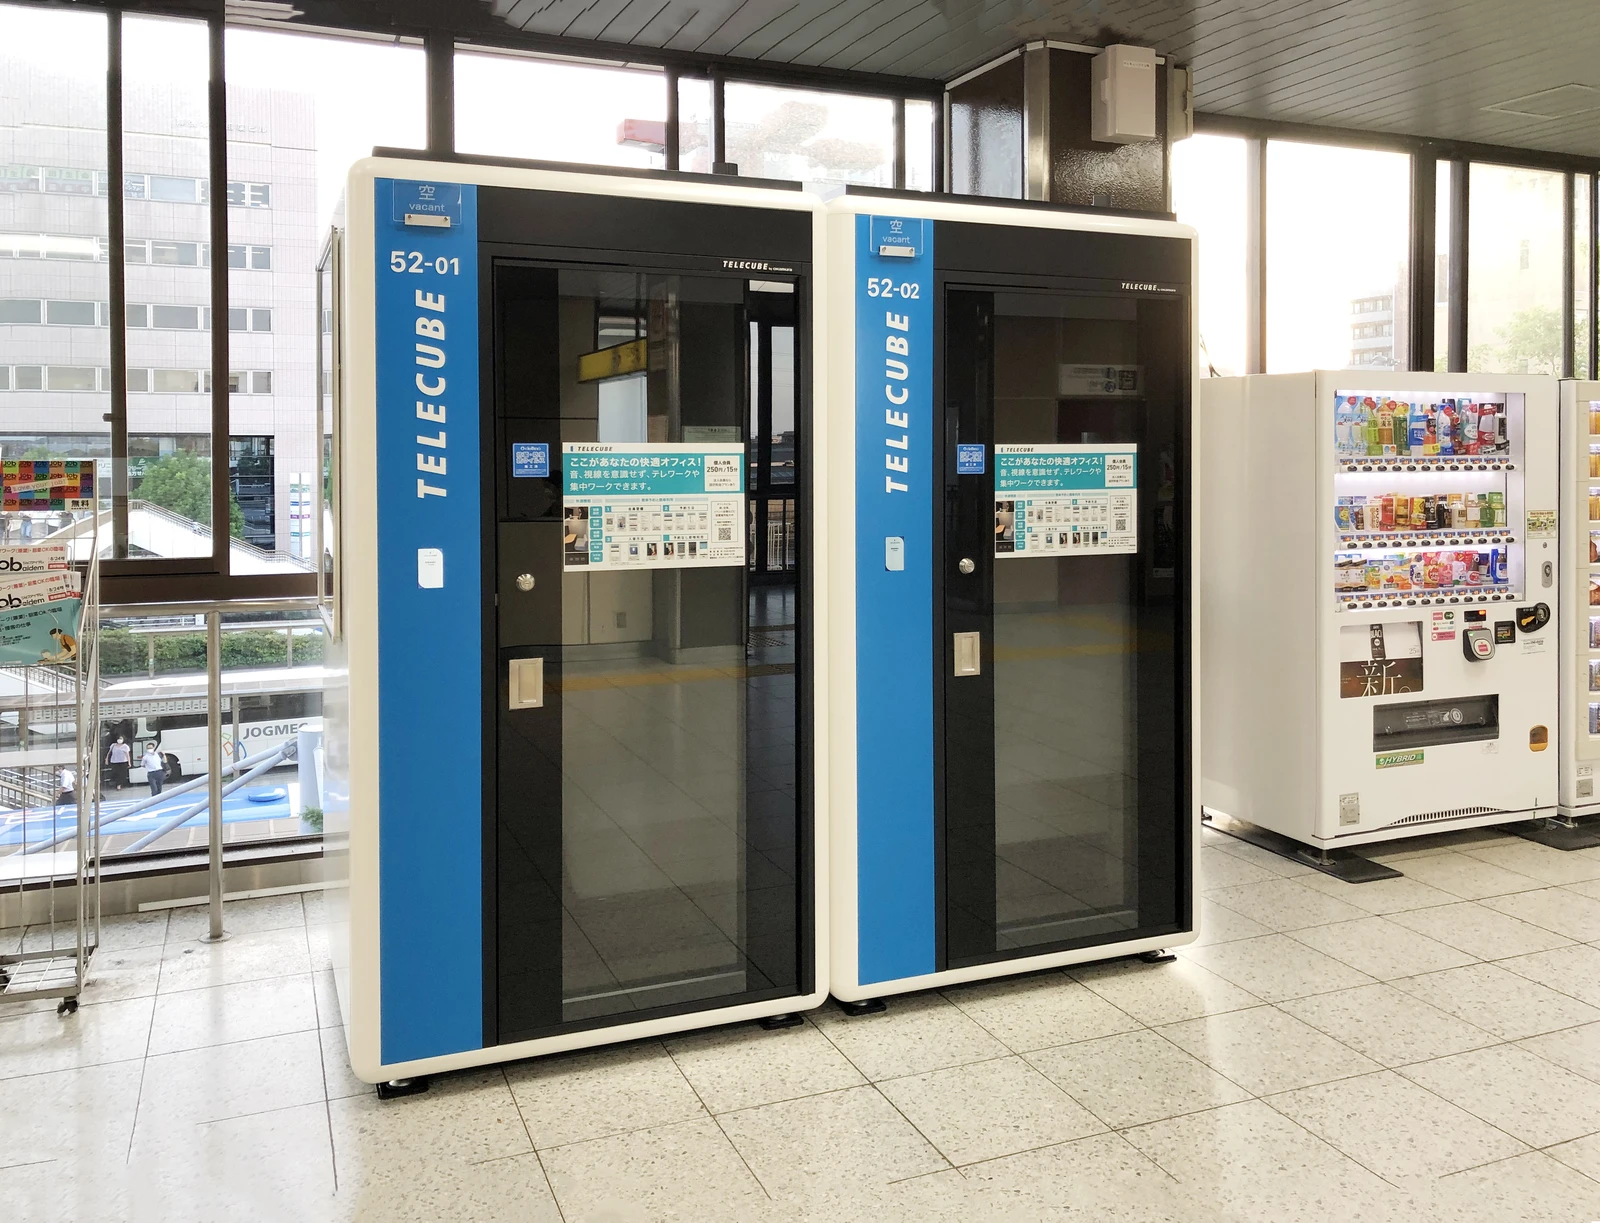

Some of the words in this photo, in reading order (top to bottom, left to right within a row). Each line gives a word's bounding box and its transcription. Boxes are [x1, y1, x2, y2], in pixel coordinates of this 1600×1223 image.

[418, 184, 436, 200] 空
[408, 204, 446, 212] vacant
[890, 220, 903, 234] 空
[390, 250, 459, 275] 52-01
[723, 260, 768, 270] TELECUBE
[867, 278, 919, 299] 52-02
[1122, 282, 1157, 291] TELECUBE
[415, 288, 447, 498] TELECUBE
[885, 312, 909, 494] TELECUBE
[570, 457, 701, 467] ここがあなたの快適オフィス！
[569, 469, 700, 479] 音、視線を意識せず、テレワークや
[569, 482, 652, 491] 集中ワークできます。
[1000, 479, 1064, 488] 集中ワークできます。
[23, 598, 44, 606] aidem
[1384, 754, 1416, 766] HYBRID
